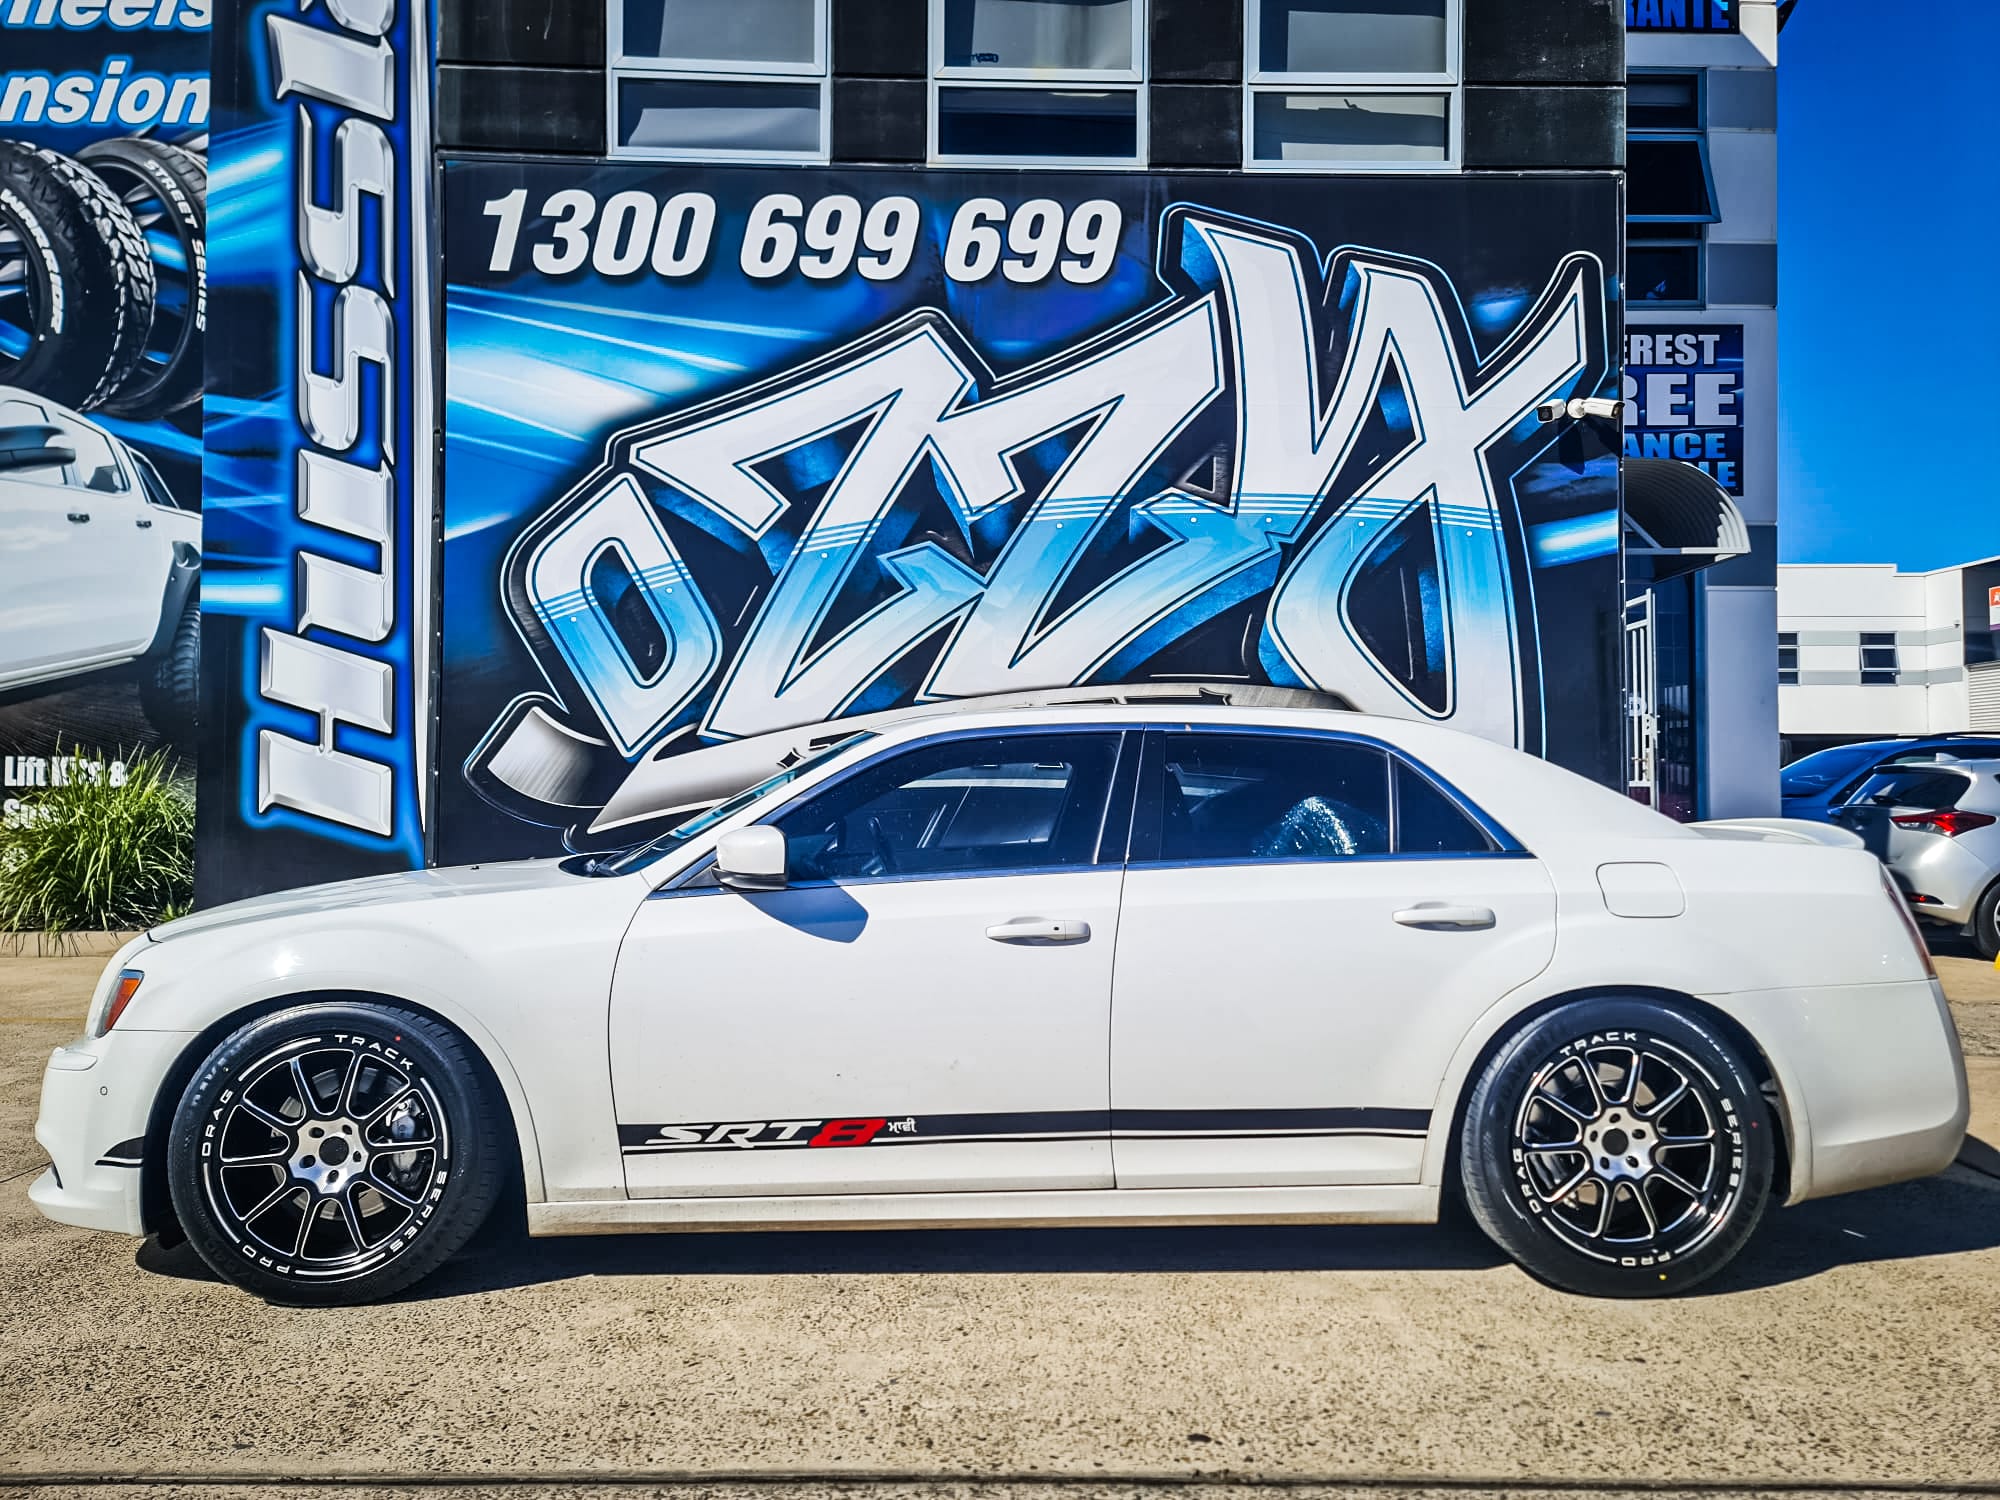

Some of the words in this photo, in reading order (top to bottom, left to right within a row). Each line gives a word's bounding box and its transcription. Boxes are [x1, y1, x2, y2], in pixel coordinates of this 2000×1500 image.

[143, 159, 199, 229] STREET
[481, 188, 717, 278] 1300
[739, 194, 920, 281] 699
[944, 198, 1123, 284] 699
[1624, 333, 1721, 366] REST
[4, 755, 47, 787] Lift
[334, 1033, 415, 1070] TRACK
[1559, 1031, 1638, 1057] TRACK
[201, 1088, 235, 1157] DRAG
[1719, 1097, 1745, 1195] SERIES
[389, 1169, 449, 1254] SERIES
[1511, 1147, 1544, 1214] DRAG
[241, 1244, 291, 1275] PRO
